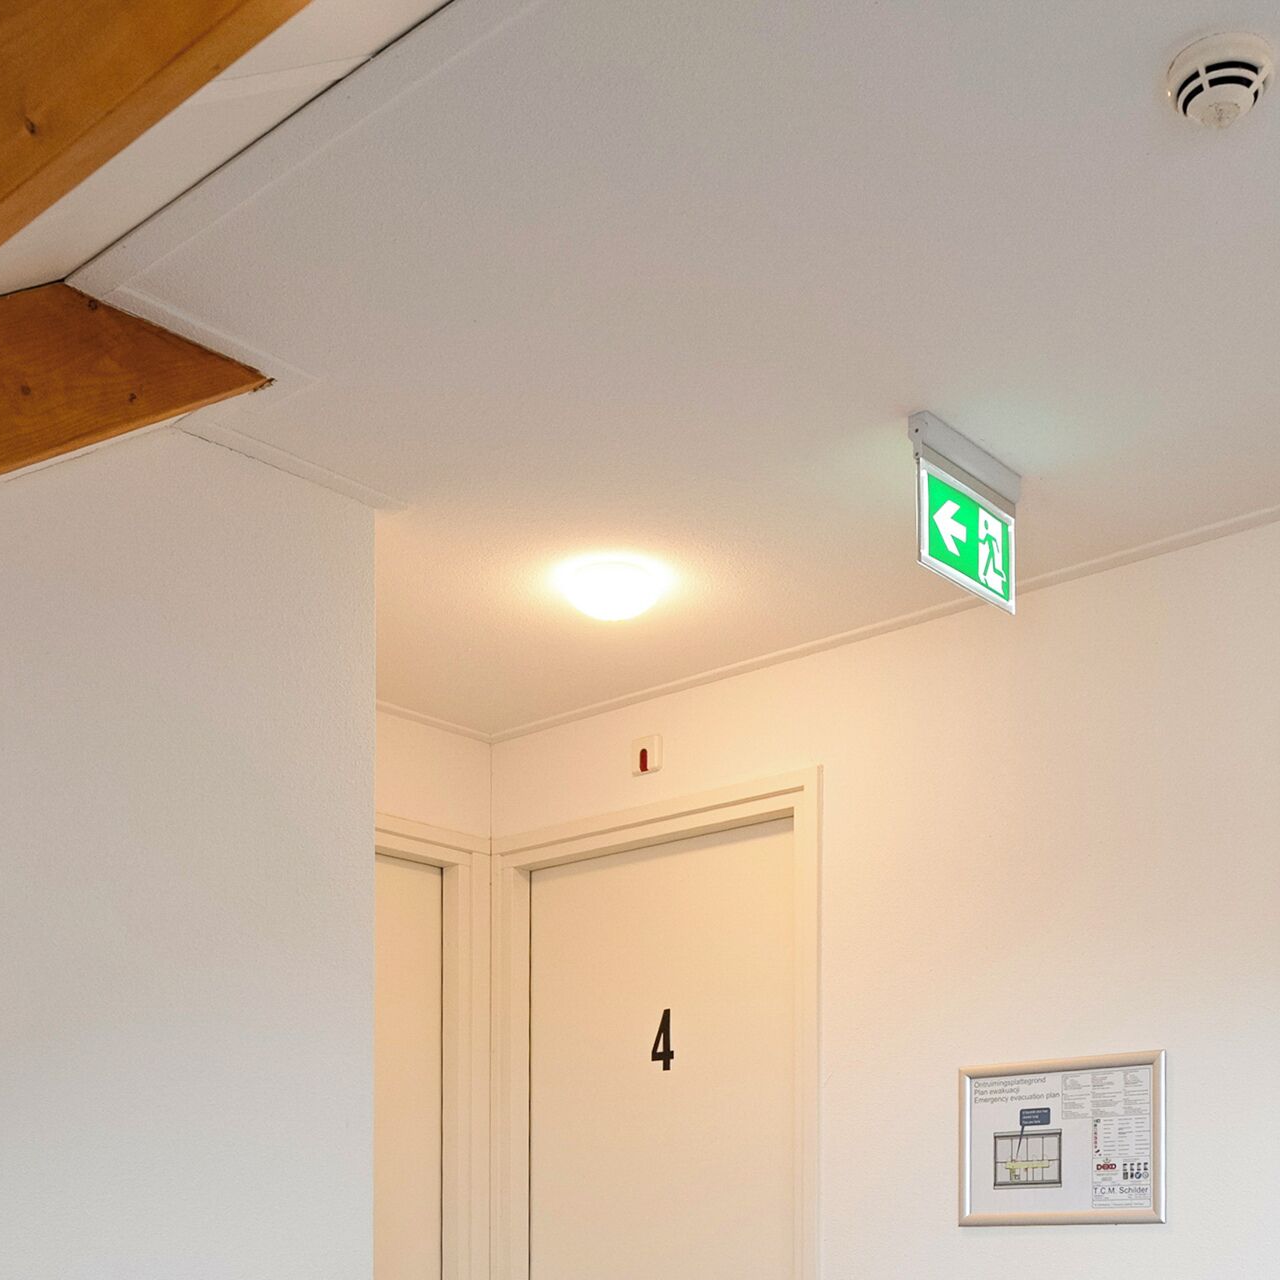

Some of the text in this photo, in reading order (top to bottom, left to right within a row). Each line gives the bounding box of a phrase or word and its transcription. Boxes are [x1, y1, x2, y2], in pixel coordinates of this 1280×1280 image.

[651, 1008, 674, 1071] 4
[974, 1096, 1008, 1104] Emergency
[1010, 1093, 1044, 1101] evacuation
